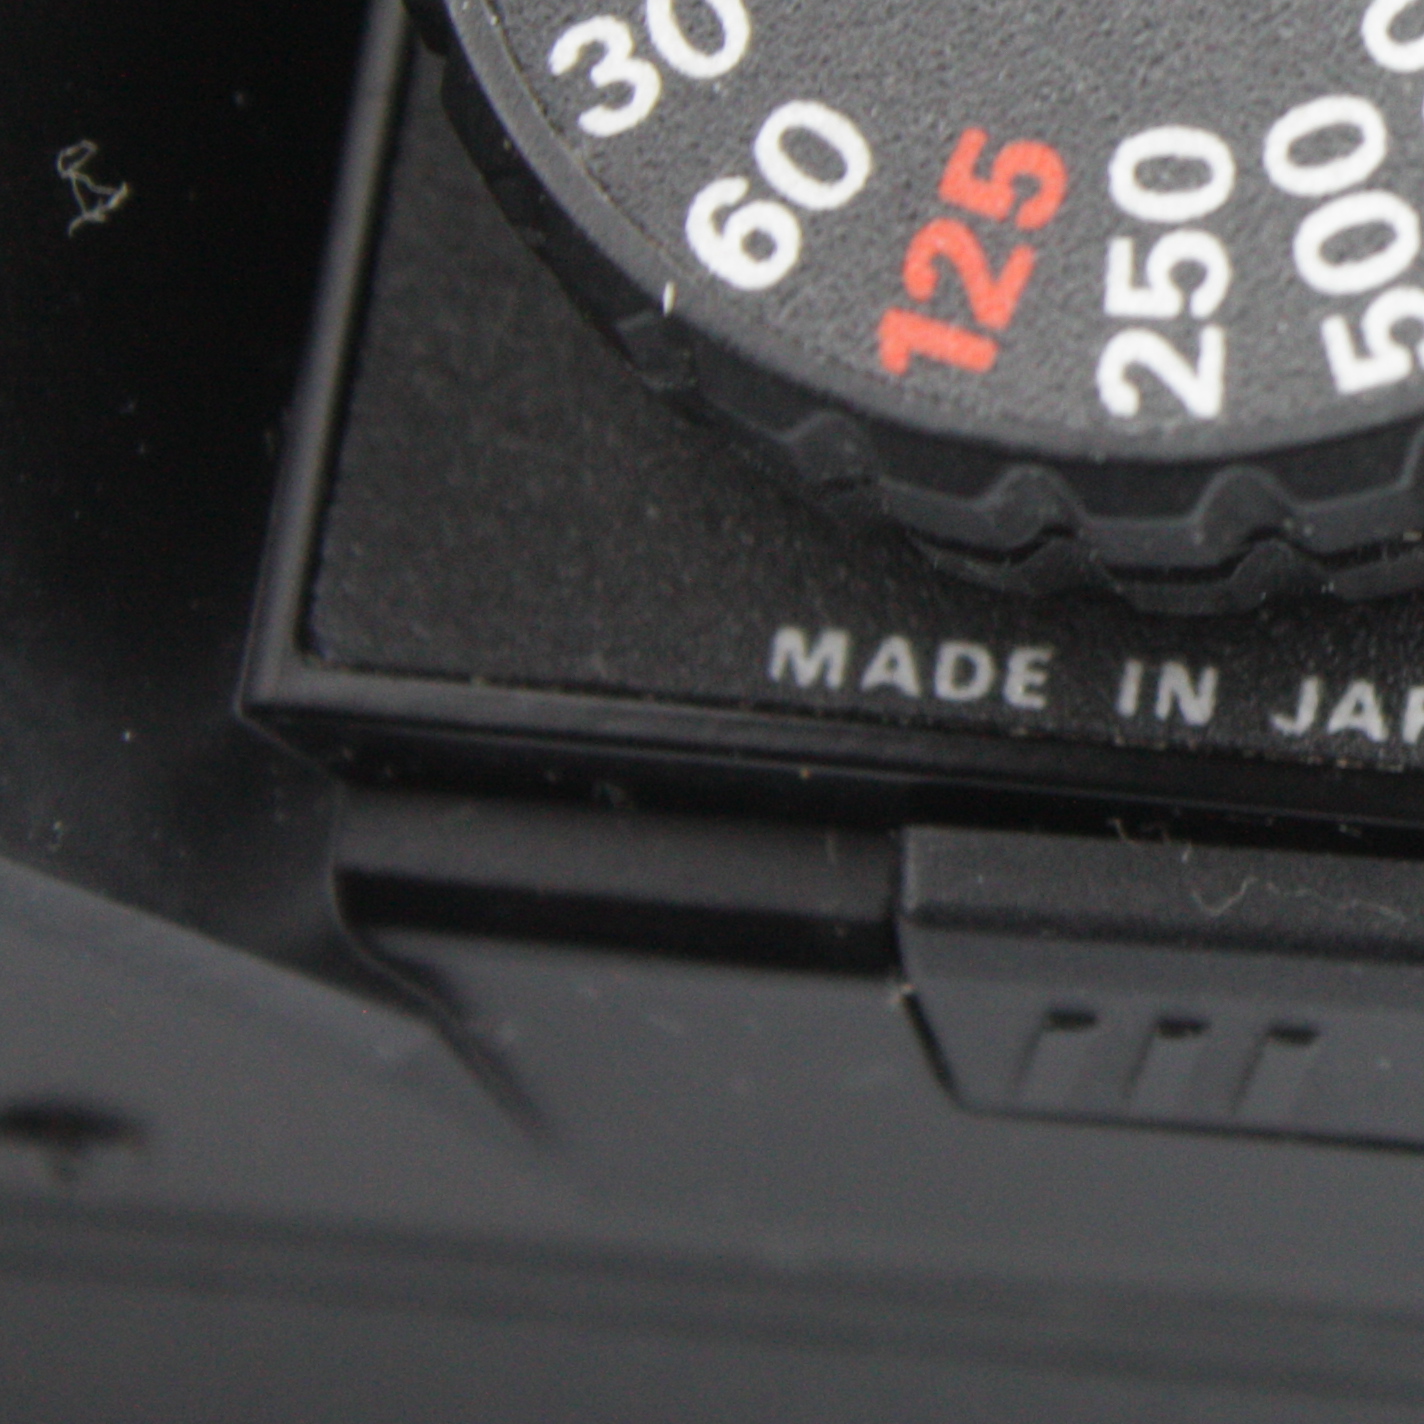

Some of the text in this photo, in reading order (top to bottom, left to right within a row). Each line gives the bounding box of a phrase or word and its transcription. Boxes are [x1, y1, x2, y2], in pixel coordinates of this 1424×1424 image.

[684, 100, 873, 291] 60
[877, 127, 1068, 374] 125
[1095, 125, 1236, 418] 250
[767, 626, 1051, 710] MADE
[1115, 660, 1218, 727] IN
